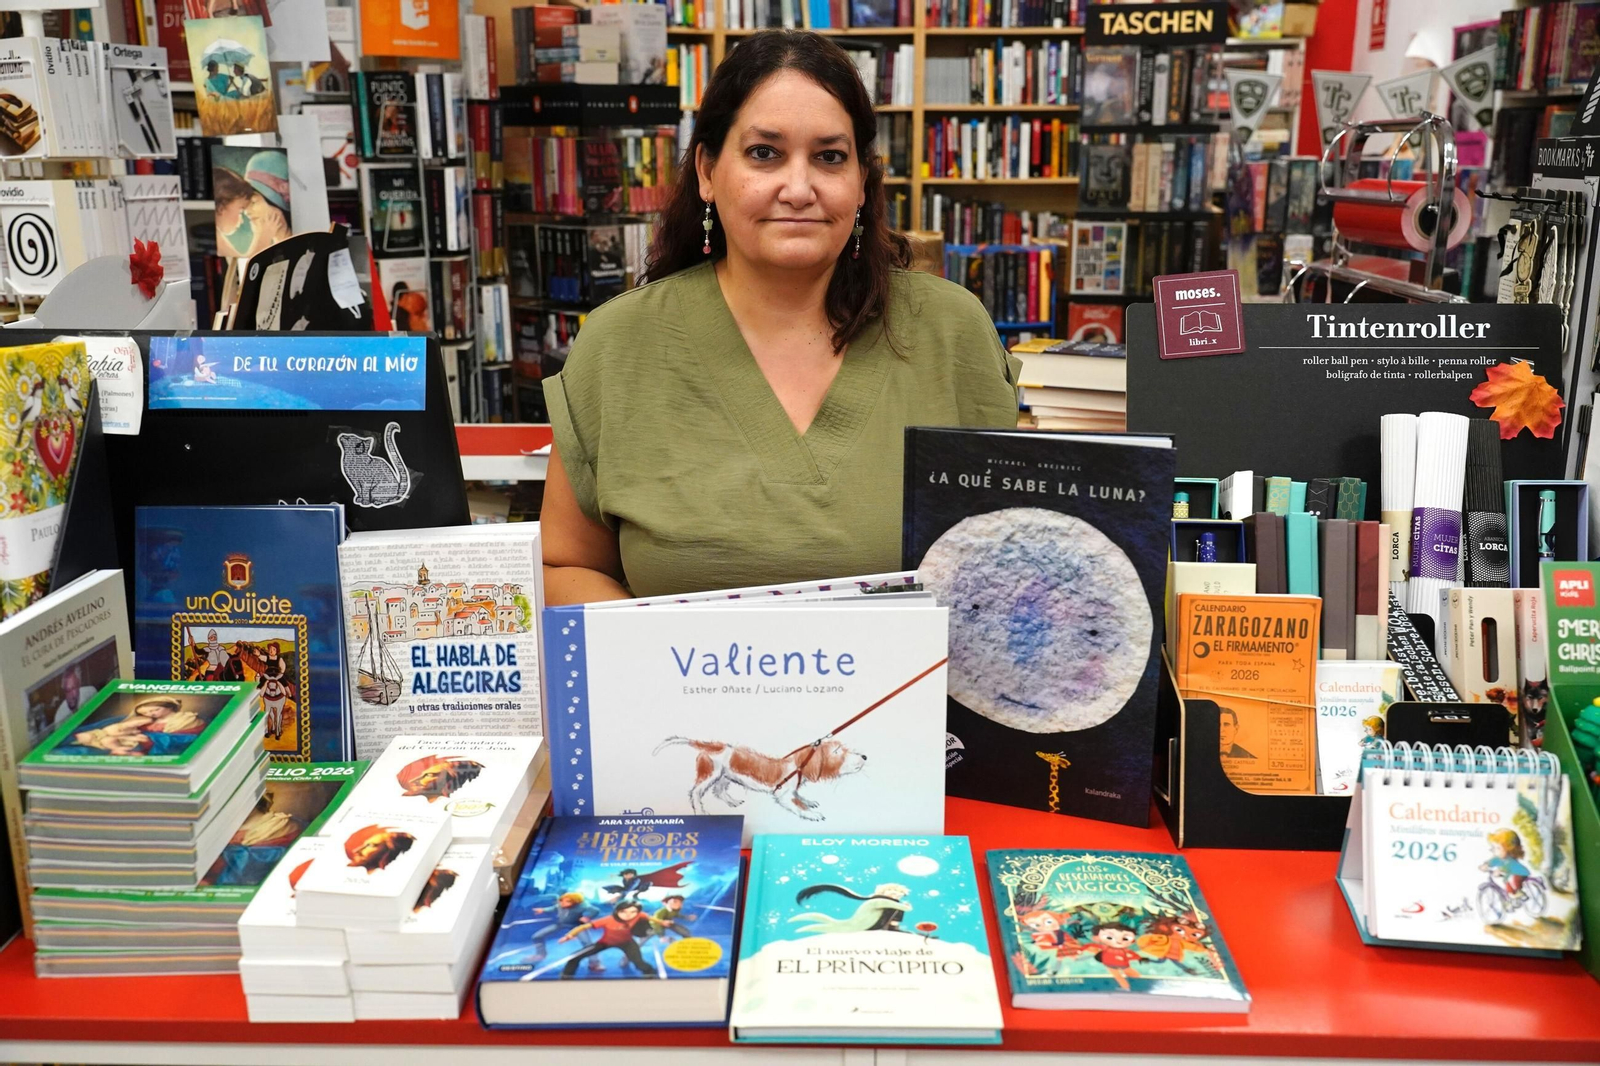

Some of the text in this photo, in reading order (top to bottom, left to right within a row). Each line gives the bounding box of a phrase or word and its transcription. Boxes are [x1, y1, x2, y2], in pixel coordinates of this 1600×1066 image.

[1099, 9, 1214, 36] TASCHEN
[114, 46, 143, 61] Ortega
[1538, 147, 1581, 167] BOOKMARKS
[1175, 287, 1221, 301] moses.
[1306, 314, 1491, 339] Tintenroller
[1189, 337, 1217, 346] libri_x
[233, 354, 419, 372] DE TU CORAZÓN AL MÍO
[1302, 356, 1497, 368] roller ball pen stylo à bille penna roller
[1325, 370, 1473, 382] bolígrafo de tinta rollerbalpen
[101, 389, 135, 398] (Palmones)
[987, 458, 1027, 467] MICHAEL
[928, 469, 1146, 502] ¿A QUÉ SABE LA LUNA?
[1392, 531, 1400, 560] LORCA
[1479, 542, 1508, 552] LORCA
[1559, 580, 1589, 590] APLI
[1194, 603, 1247, 614] CALENDARIO
[24, 596, 106, 650] ANDRÉS AVELINO
[1192, 614, 1309, 640] ZARAGOZANO
[21, 655, 31, 667] EL
[53, 635, 65, 648] DE
[66, 609, 112, 641] PESCADORES
[1213, 640, 1295, 654] EL FIRMAMENTO
[411, 643, 517, 667] EL HABLA DE
[670, 642, 856, 677] Valiente
[1230, 669, 1260, 681] 2026
[118, 683, 205, 692] EVANGELIO
[412, 670, 522, 695] ALGECIRAS
[683, 685, 718, 694] Esther
[721, 685, 752, 694] Oñate
[763, 685, 802, 694] Luciano
[806, 685, 844, 694] Lozano
[1319, 682, 1382, 693] Calendario
[409, 701, 521, 714] y otras tradiciones orales
[1320, 705, 1357, 717] 2026
[309, 767, 355, 776] 2026
[1389, 801, 1501, 824] Calendario
[624, 818, 685, 826] SANTAMARÍA
[576, 831, 700, 849] HÉROES
[801, 838, 930, 847] ELOY MORENO
[599, 846, 698, 863] TIEMPO
[1392, 840, 1458, 862] 2026
[1082, 865, 1102, 873] LOS
[806, 947, 824, 955] El
[875, 948, 912, 958] viaje
[915, 947, 933, 956] de
[776, 959, 810, 974] EL
